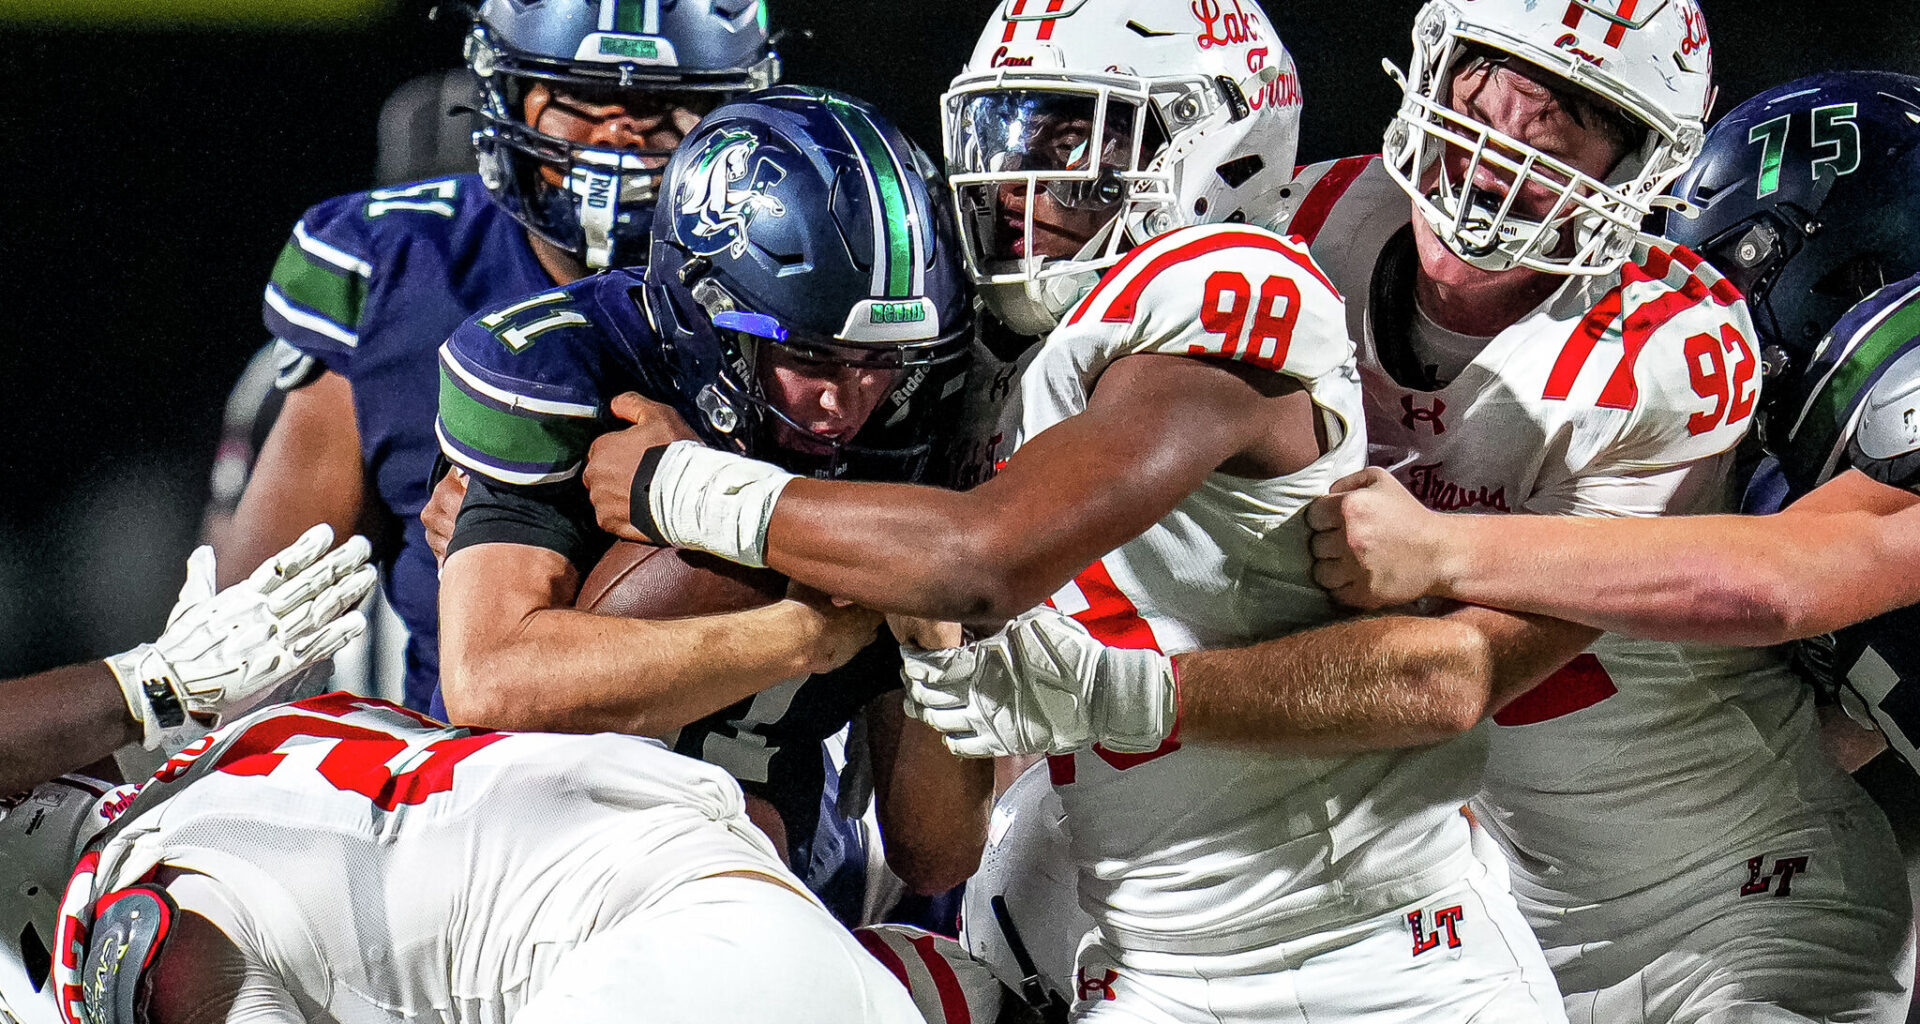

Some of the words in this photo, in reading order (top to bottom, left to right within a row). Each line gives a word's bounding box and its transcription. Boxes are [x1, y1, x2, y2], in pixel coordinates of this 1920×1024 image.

[1747, 102, 1861, 200] 75
[587, 177, 612, 209] RND
[475, 291, 592, 355] 11
[1187, 270, 1301, 372] 98
[889, 350, 935, 407] Ridde
[1683, 322, 1756, 437] 92
[1740, 855, 1809, 897] LT
[1407, 905, 1464, 957] LT
